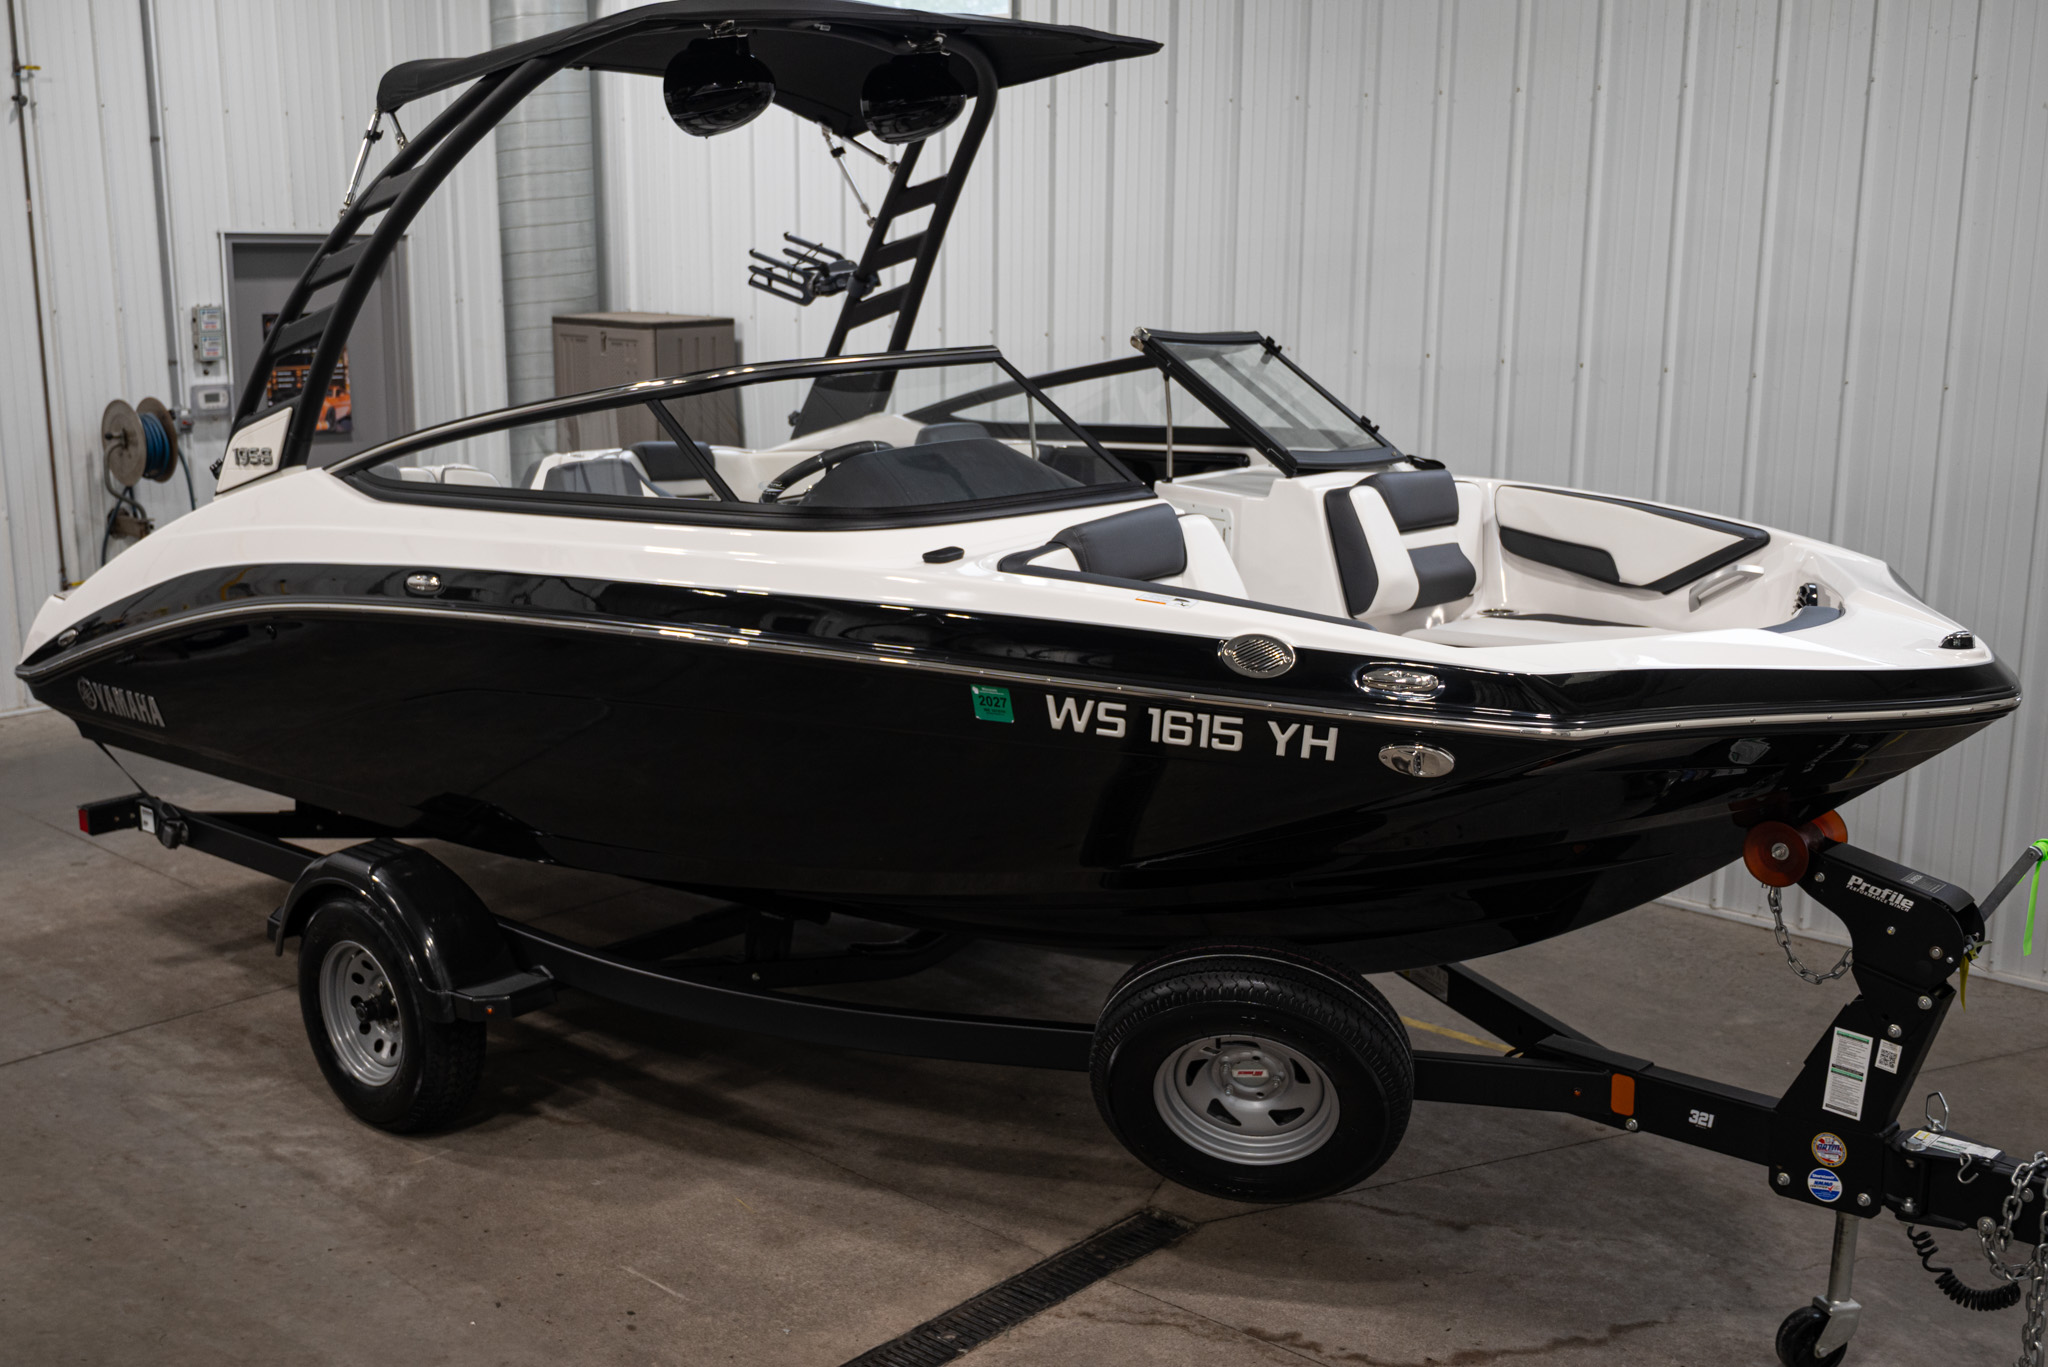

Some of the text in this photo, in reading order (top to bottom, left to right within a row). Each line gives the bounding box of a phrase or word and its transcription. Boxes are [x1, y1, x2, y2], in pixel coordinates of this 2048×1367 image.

[92, 682, 165, 727] YAMAHA
[979, 695, 1007, 708] 2027
[1046, 694, 1339, 761] WS 1615 YH
[1845, 884, 1910, 912] PERFORMANCE WINCH
[1847, 875, 1915, 910] Profile
[1688, 1109, 1715, 1128] 321
